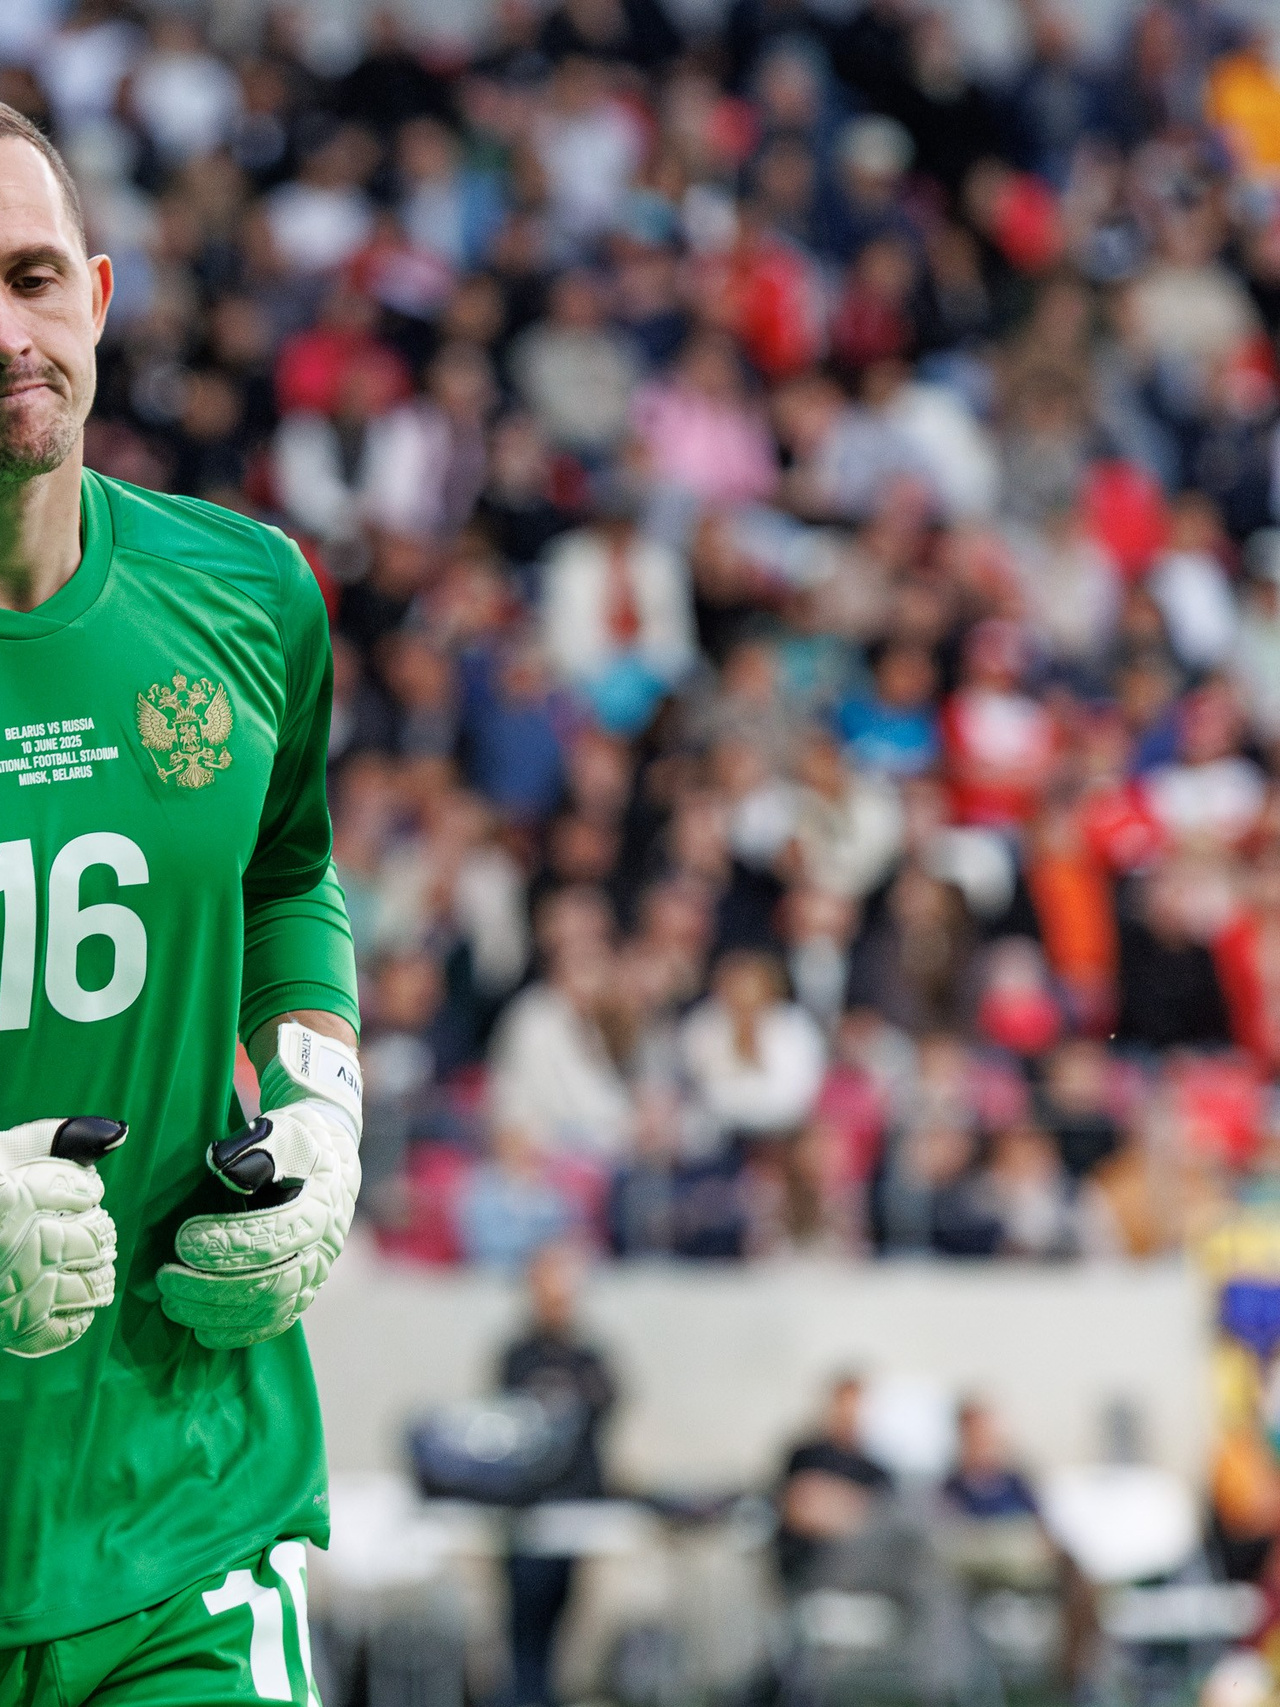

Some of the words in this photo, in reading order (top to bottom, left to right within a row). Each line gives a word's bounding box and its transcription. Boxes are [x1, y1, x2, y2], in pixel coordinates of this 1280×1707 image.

[5, 724, 45, 741] BELARUS
[47, 722, 60, 735] VS
[62, 717, 95, 733] RUSSIA
[21, 741, 33, 754] 10
[34, 737, 59, 753] JUNE
[59, 735, 83, 750] 2025
[33, 751, 79, 768] FOOTBALL
[80, 746, 119, 763] STADIUM
[18, 770, 52, 786] MINSK,
[52, 765, 93, 782] BELARUS
[301, 1032, 312, 1077] EXTREME
